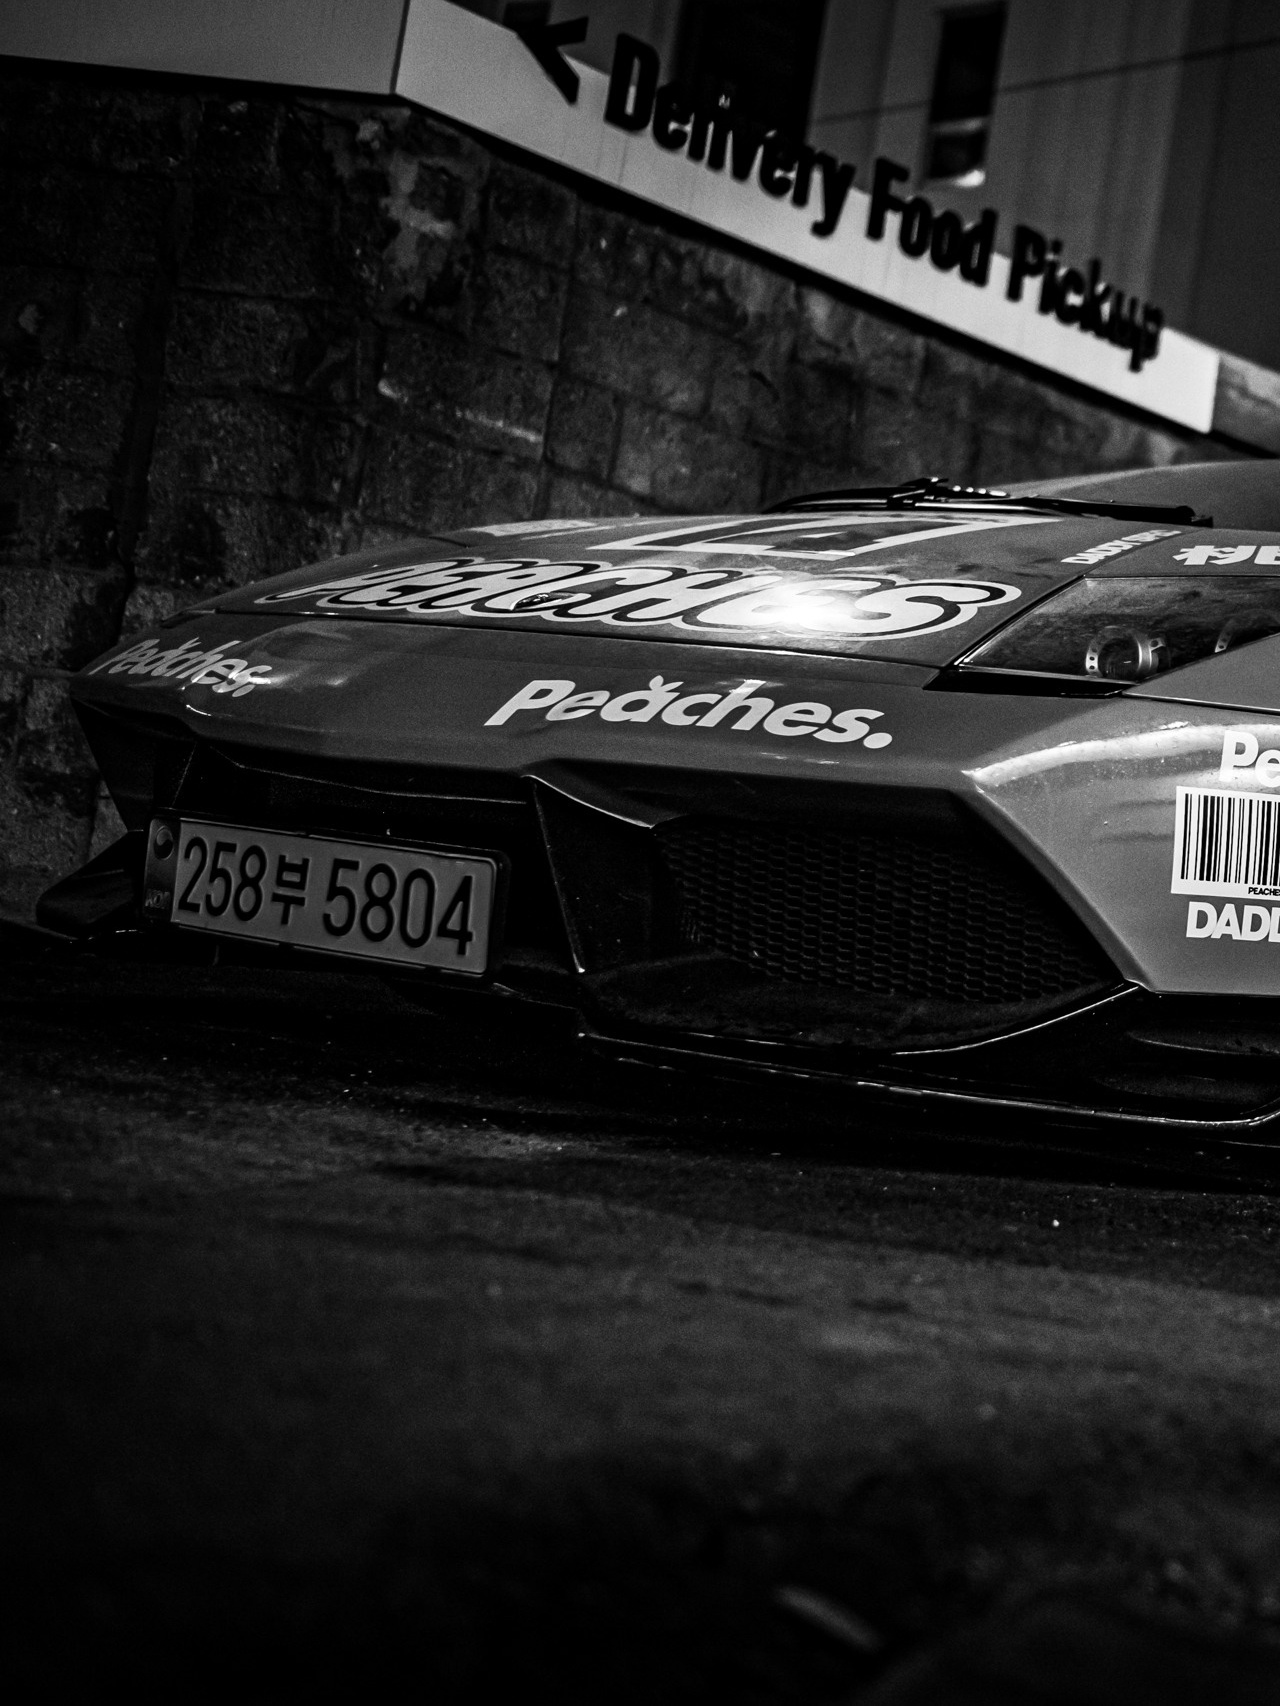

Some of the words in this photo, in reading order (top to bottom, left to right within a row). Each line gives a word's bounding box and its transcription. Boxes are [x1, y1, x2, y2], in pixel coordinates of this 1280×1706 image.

[604, 33, 855, 237] Delivery
[867, 157, 998, 287] Food
[1007, 223, 1163, 373] Pickup
[254, 556, 1022, 641] PEACHES
[484, 675, 893, 750] Peaches.
[178, 836, 310, 925] 258부
[323, 857, 473, 956] 5804
